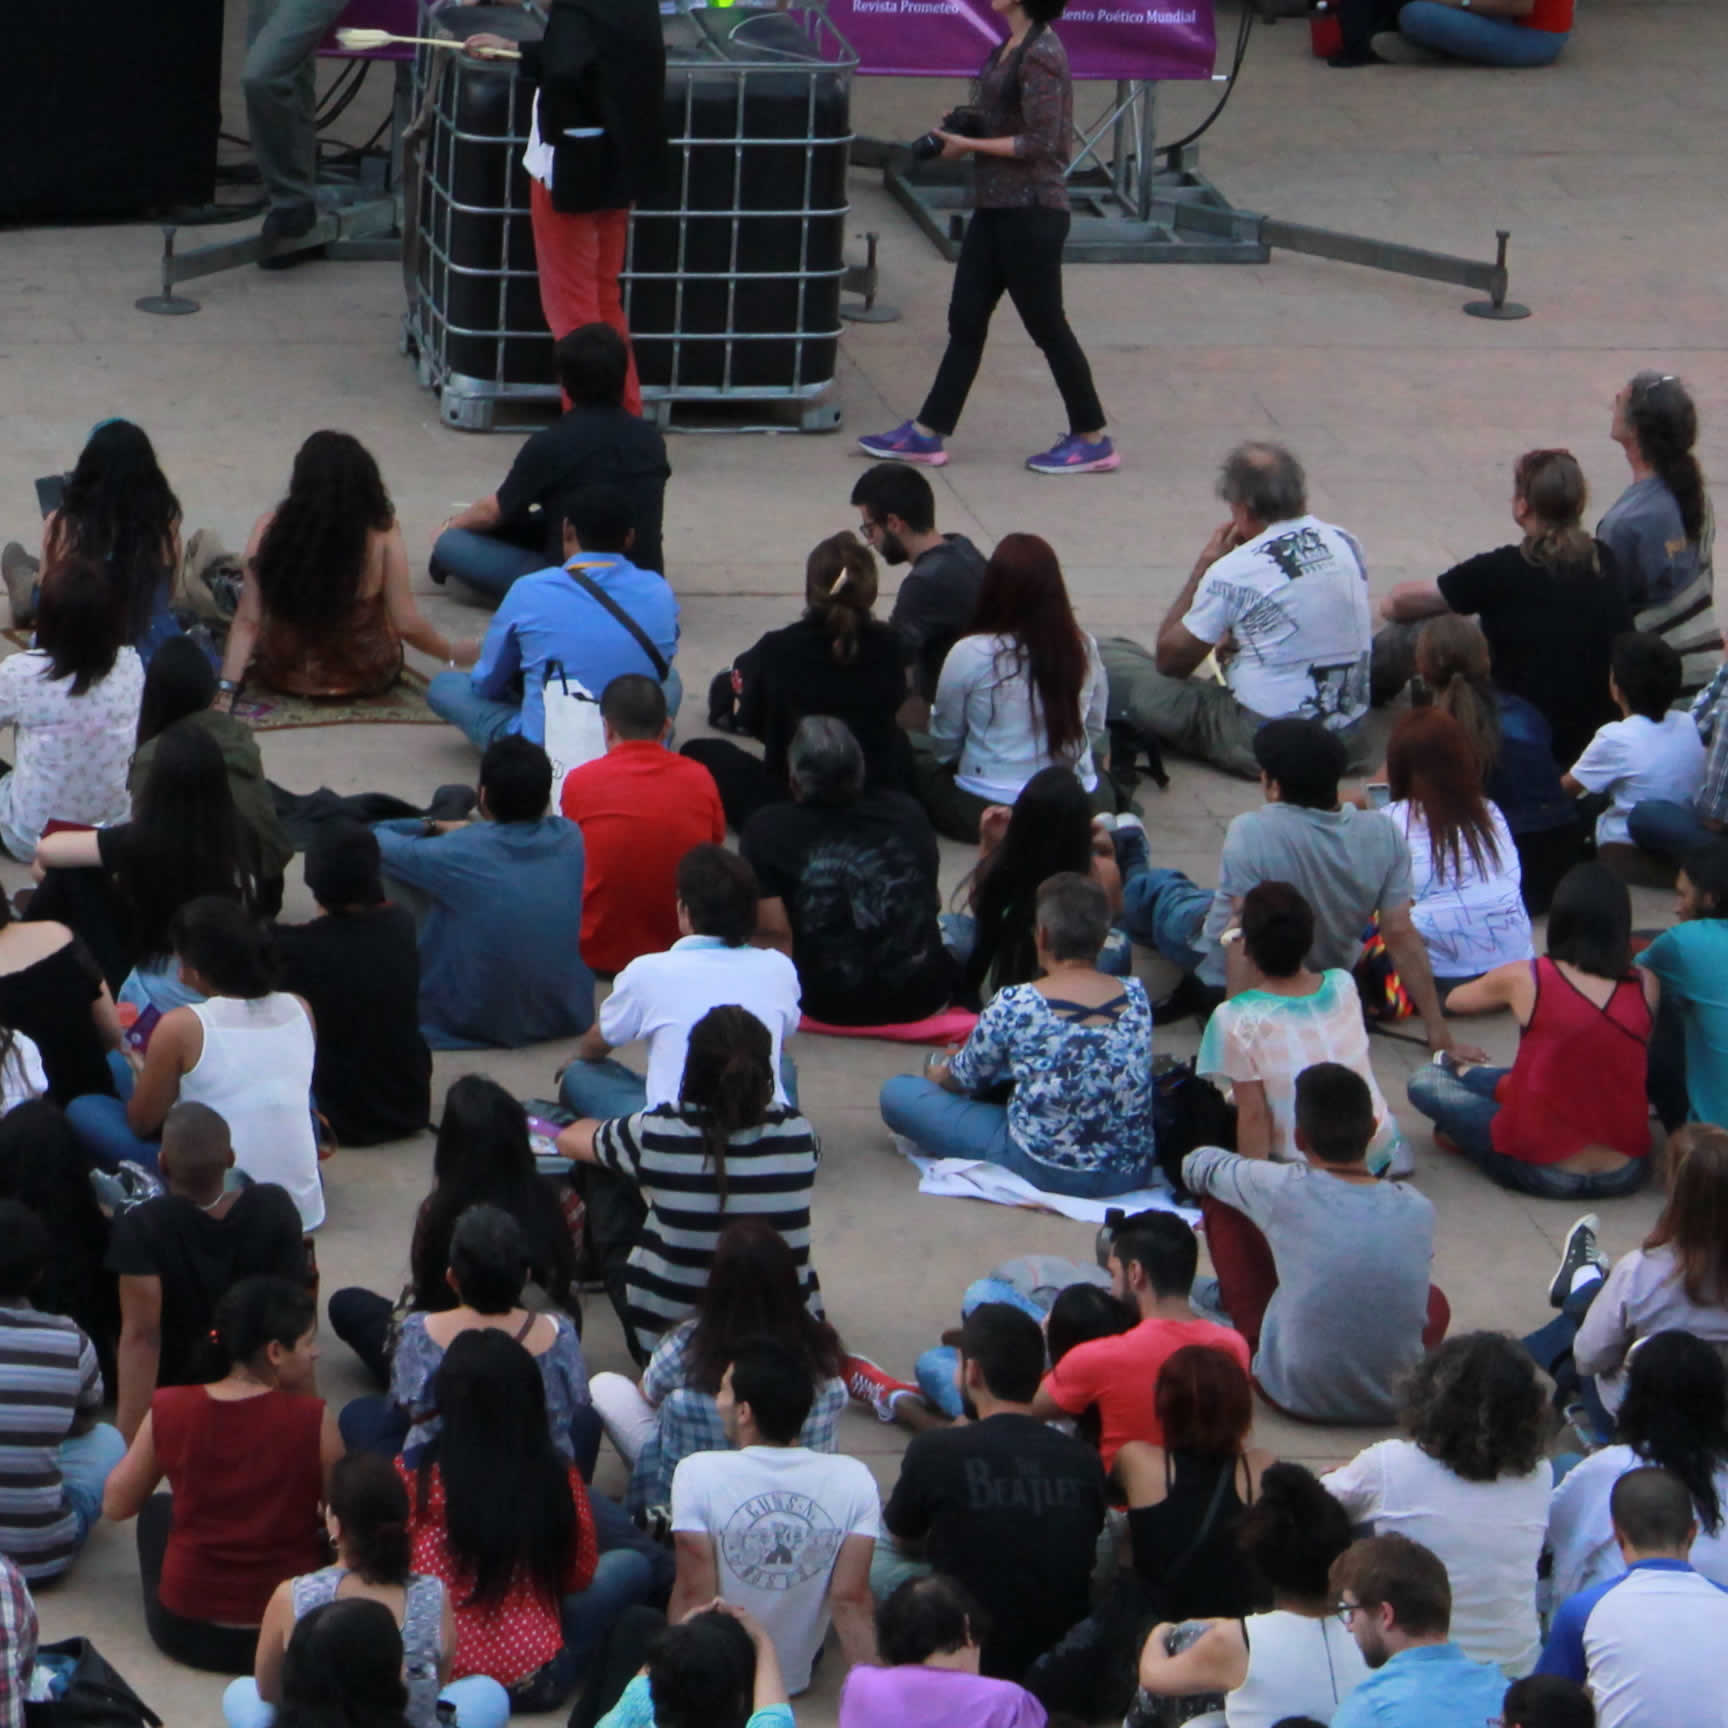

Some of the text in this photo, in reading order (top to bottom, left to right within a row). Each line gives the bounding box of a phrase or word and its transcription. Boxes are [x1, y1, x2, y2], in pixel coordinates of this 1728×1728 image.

[852, 0, 898, 13] Revista
[1098, 9, 1196, 24] Poético Mundial
